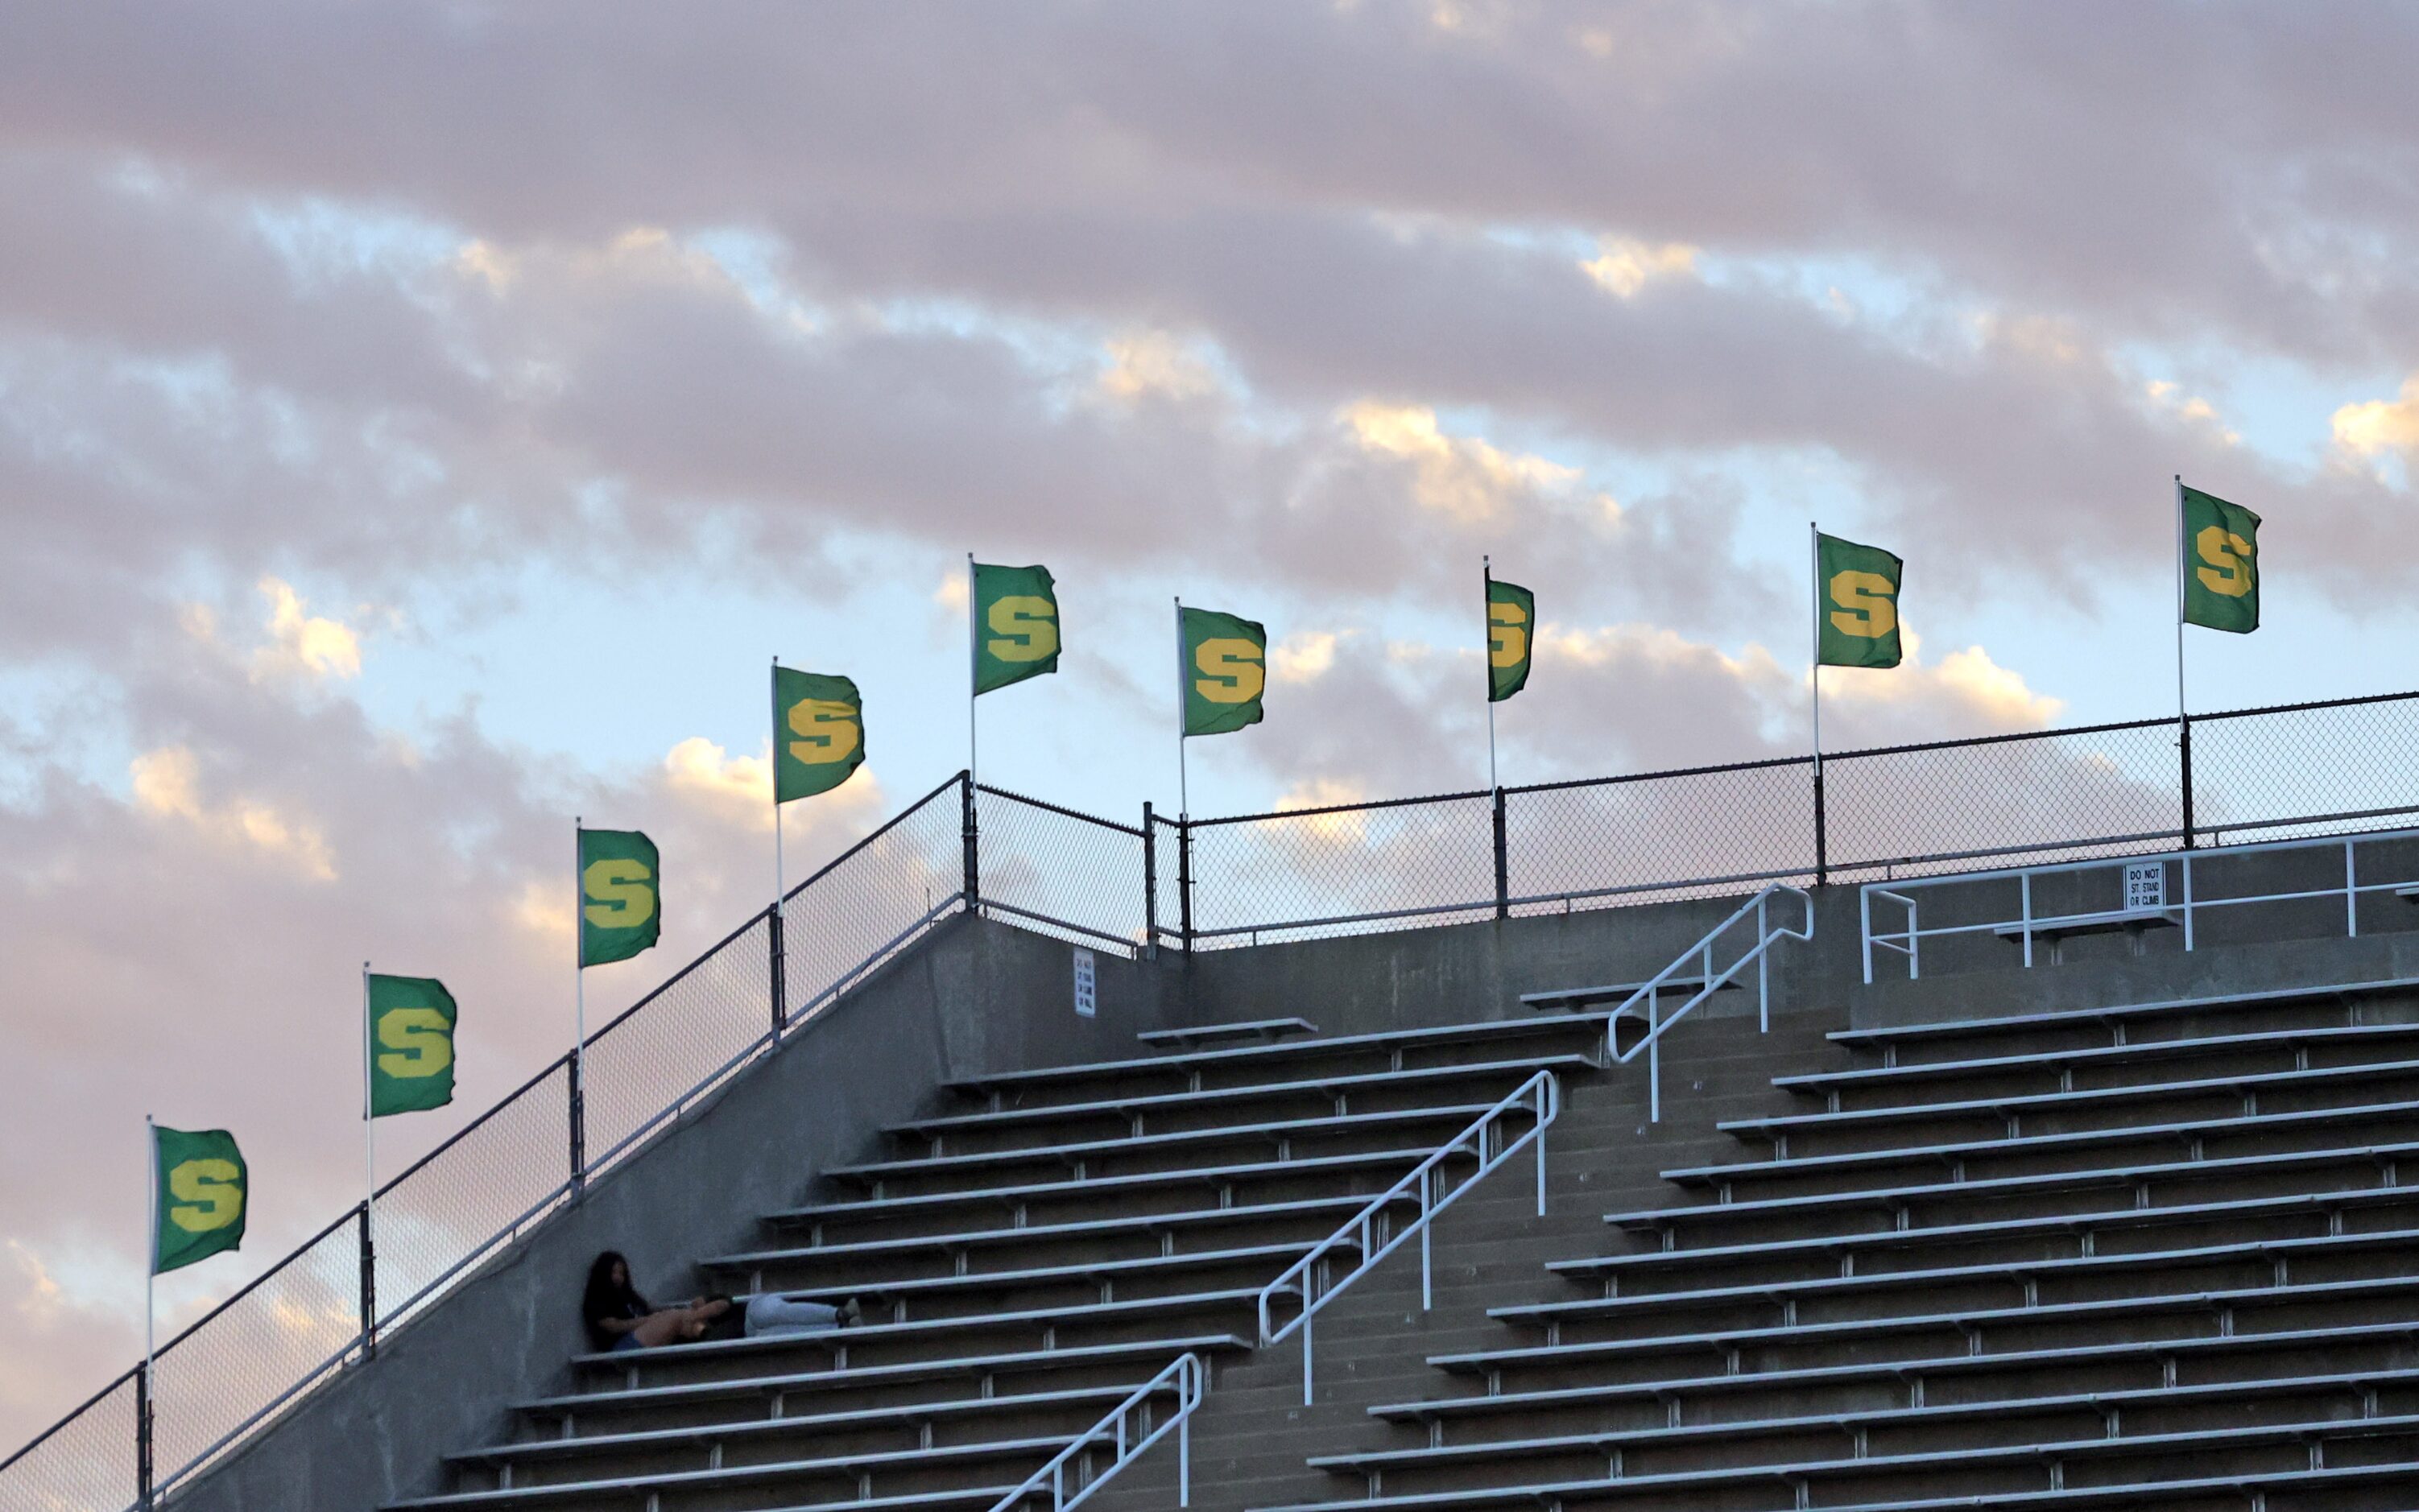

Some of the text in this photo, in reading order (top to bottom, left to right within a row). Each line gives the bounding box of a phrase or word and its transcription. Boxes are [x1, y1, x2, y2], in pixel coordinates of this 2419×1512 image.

[2197, 525, 2252, 597] S
[989, 597, 1057, 661] S
[1487, 601, 1527, 668] S
[1830, 570, 1896, 638] S
[1196, 638, 1264, 704] S
[788, 698, 859, 765] S
[585, 860, 653, 927] S
[2130, 869, 2159, 880] DO NOT
[2130, 896, 2139, 906] OR
[379, 1009, 452, 1077] S
[171, 1159, 242, 1231] S
